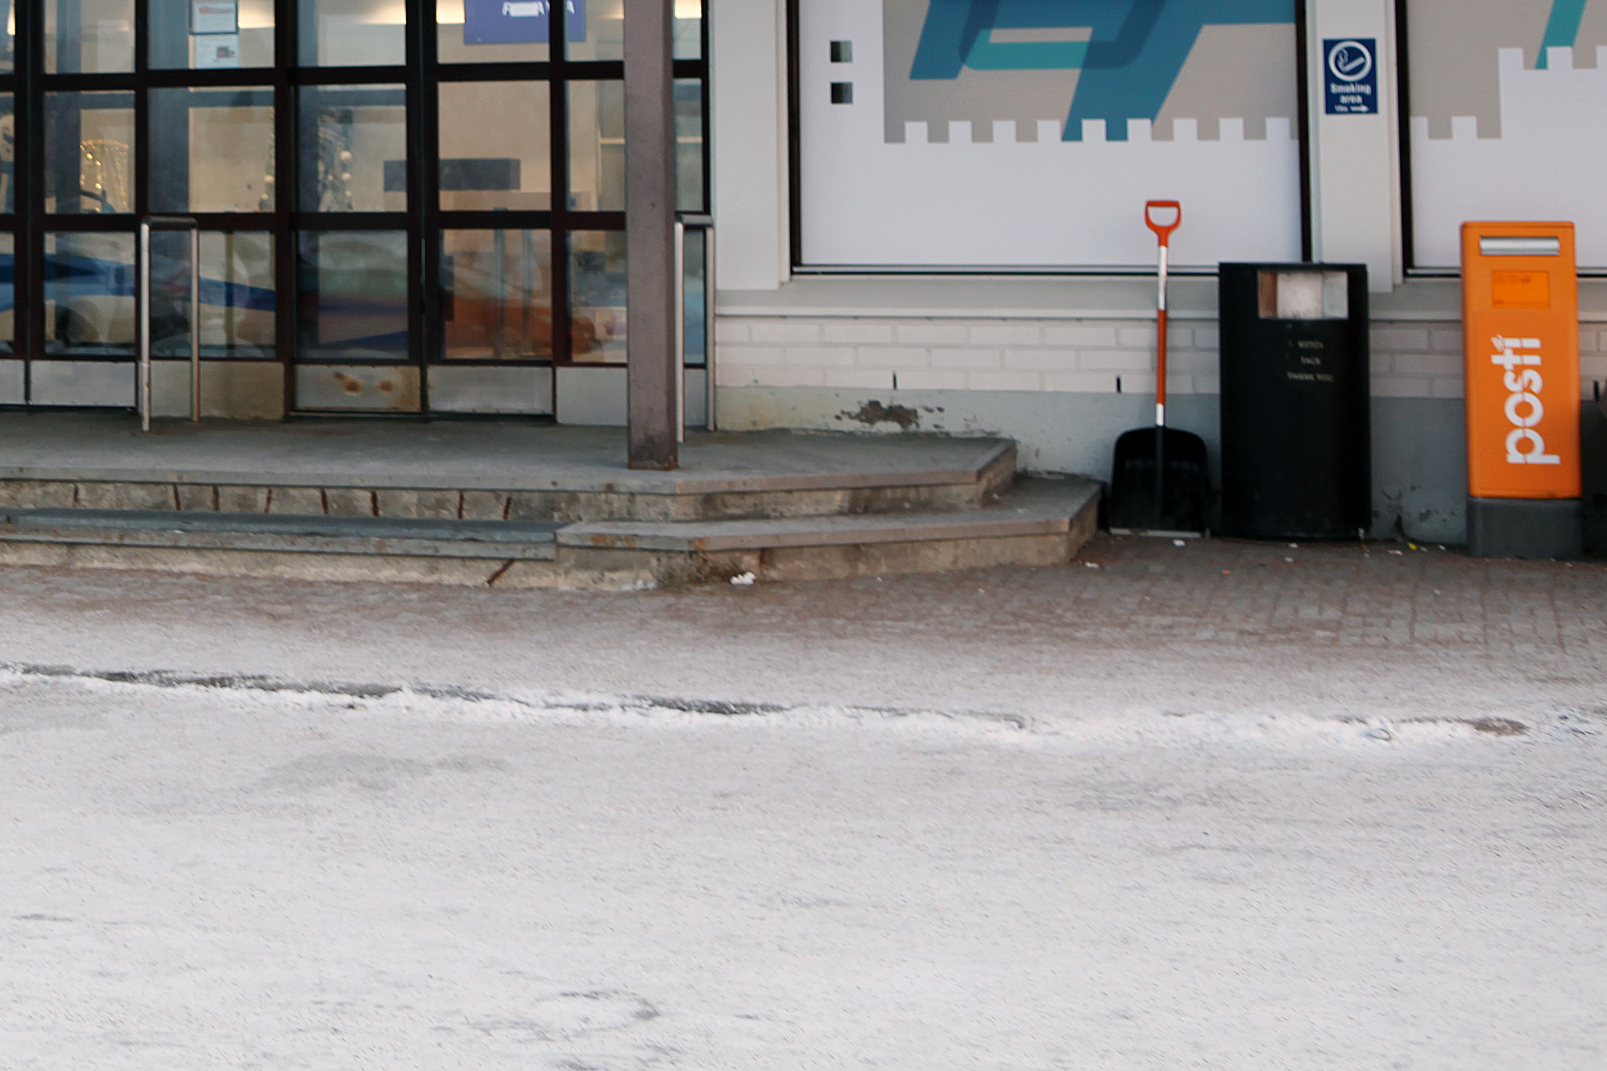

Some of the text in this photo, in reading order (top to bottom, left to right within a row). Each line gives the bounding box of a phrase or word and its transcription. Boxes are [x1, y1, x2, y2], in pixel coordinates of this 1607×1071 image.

[1330, 83, 1371, 95] Smoking
[1340, 95, 1362, 104] area
[1490, 333, 1561, 465] posti
